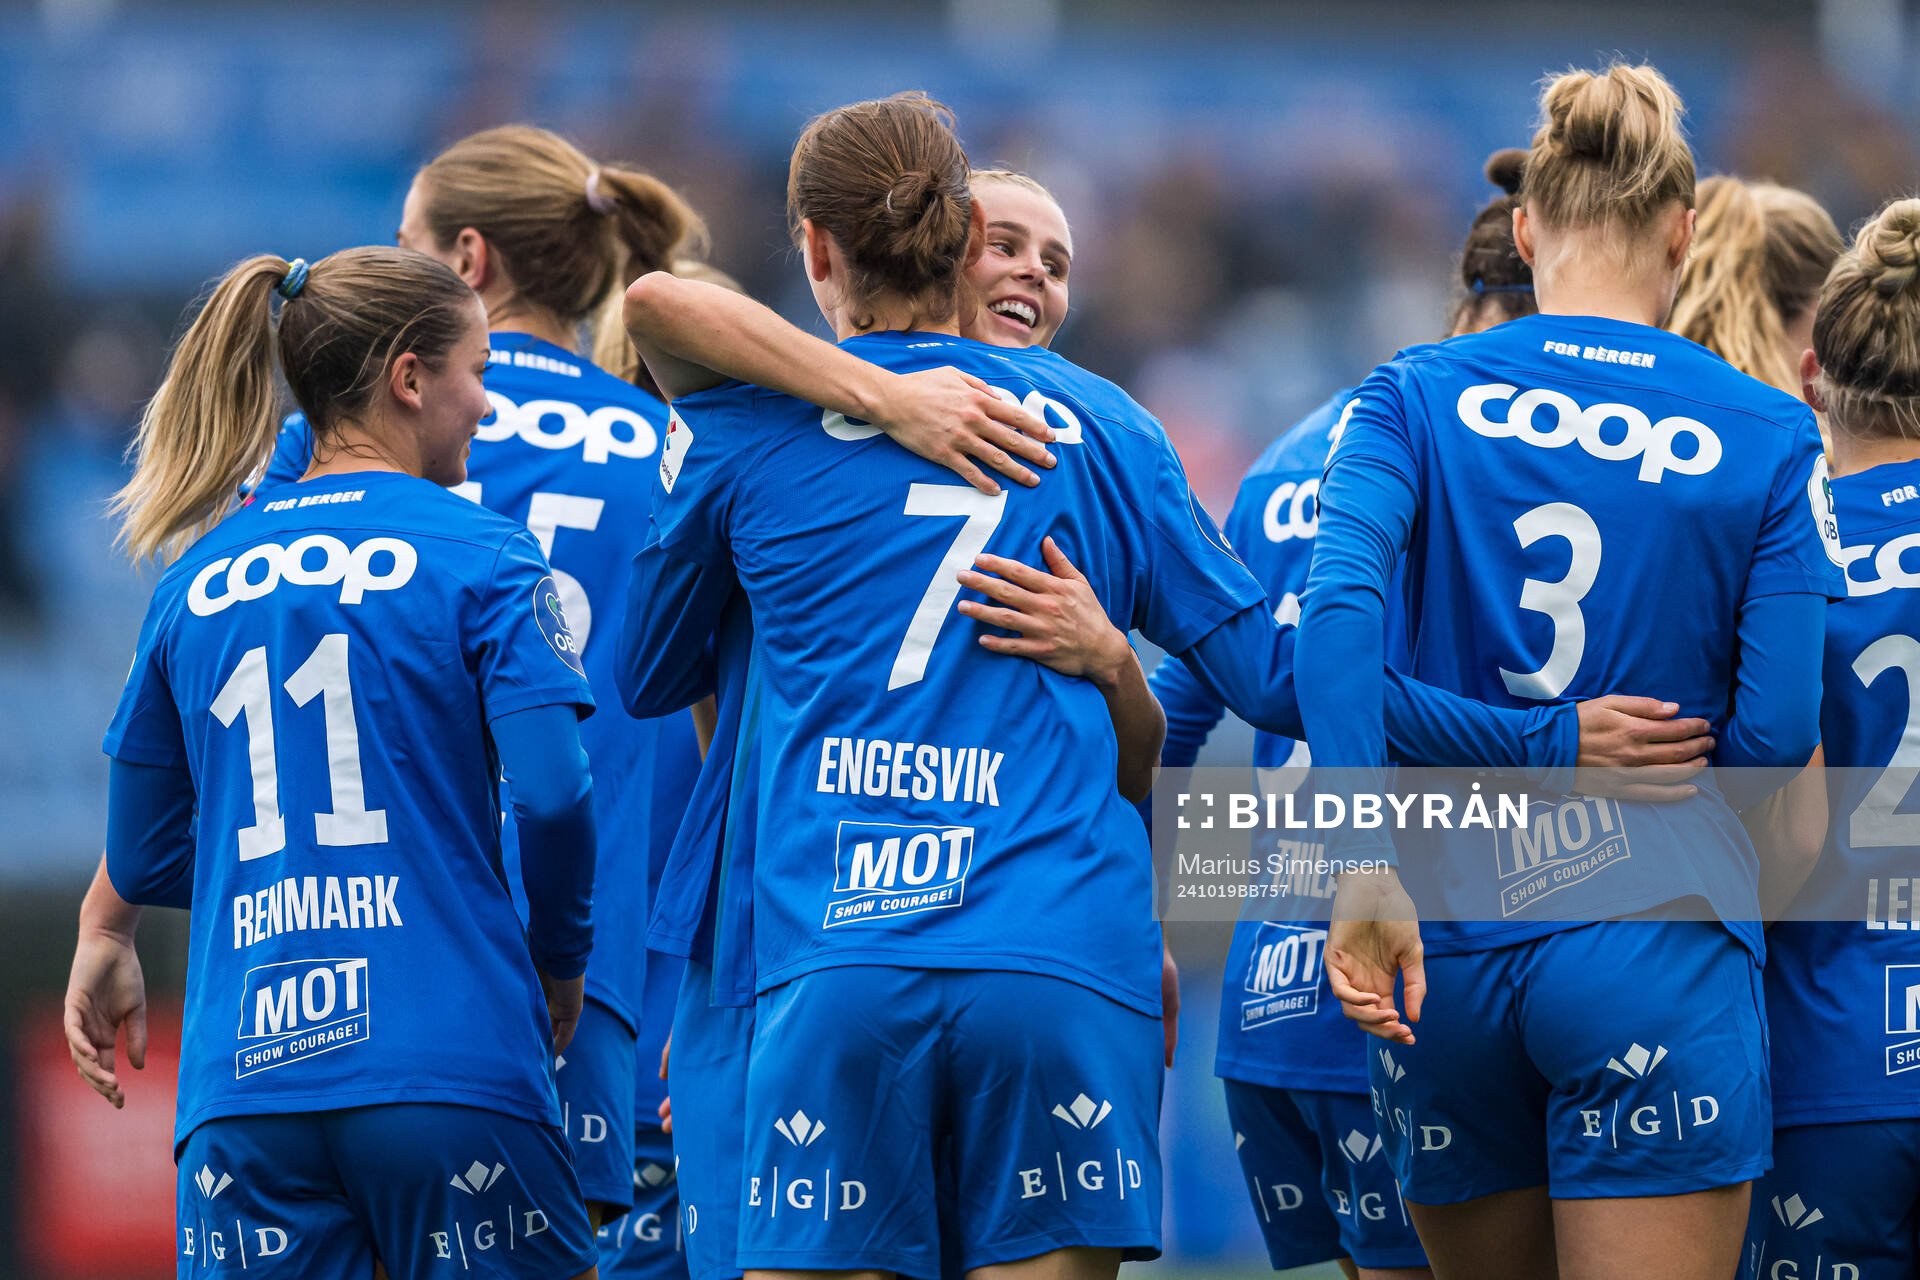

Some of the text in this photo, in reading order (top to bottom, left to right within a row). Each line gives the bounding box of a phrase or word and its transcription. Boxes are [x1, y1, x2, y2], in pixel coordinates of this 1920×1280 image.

[1543, 340, 1656, 369] FOR BERGEN
[1457, 384, 1723, 484] coop
[263, 490, 366, 513] FOR BERGEN
[1881, 485, 1920, 507] FOR
[187, 534, 417, 617] coop
[888, 482, 1008, 692] 7
[1499, 502, 1602, 700] 3
[209, 633, 389, 861] 11
[817, 737, 1004, 806] ENGESVIK
[850, 829, 974, 890] MOT
[1511, 795, 1614, 872] MOT
[834, 888, 953, 919] SHOW COURAGE!
[1511, 842, 1620, 905] SHOW COURAGE!
[234, 875, 403, 949] RENMARK
[1254, 932, 1327, 993] MOT
[255, 959, 367, 1036] MOT
[244, 1023, 359, 1068] SHOW COURAGE!
